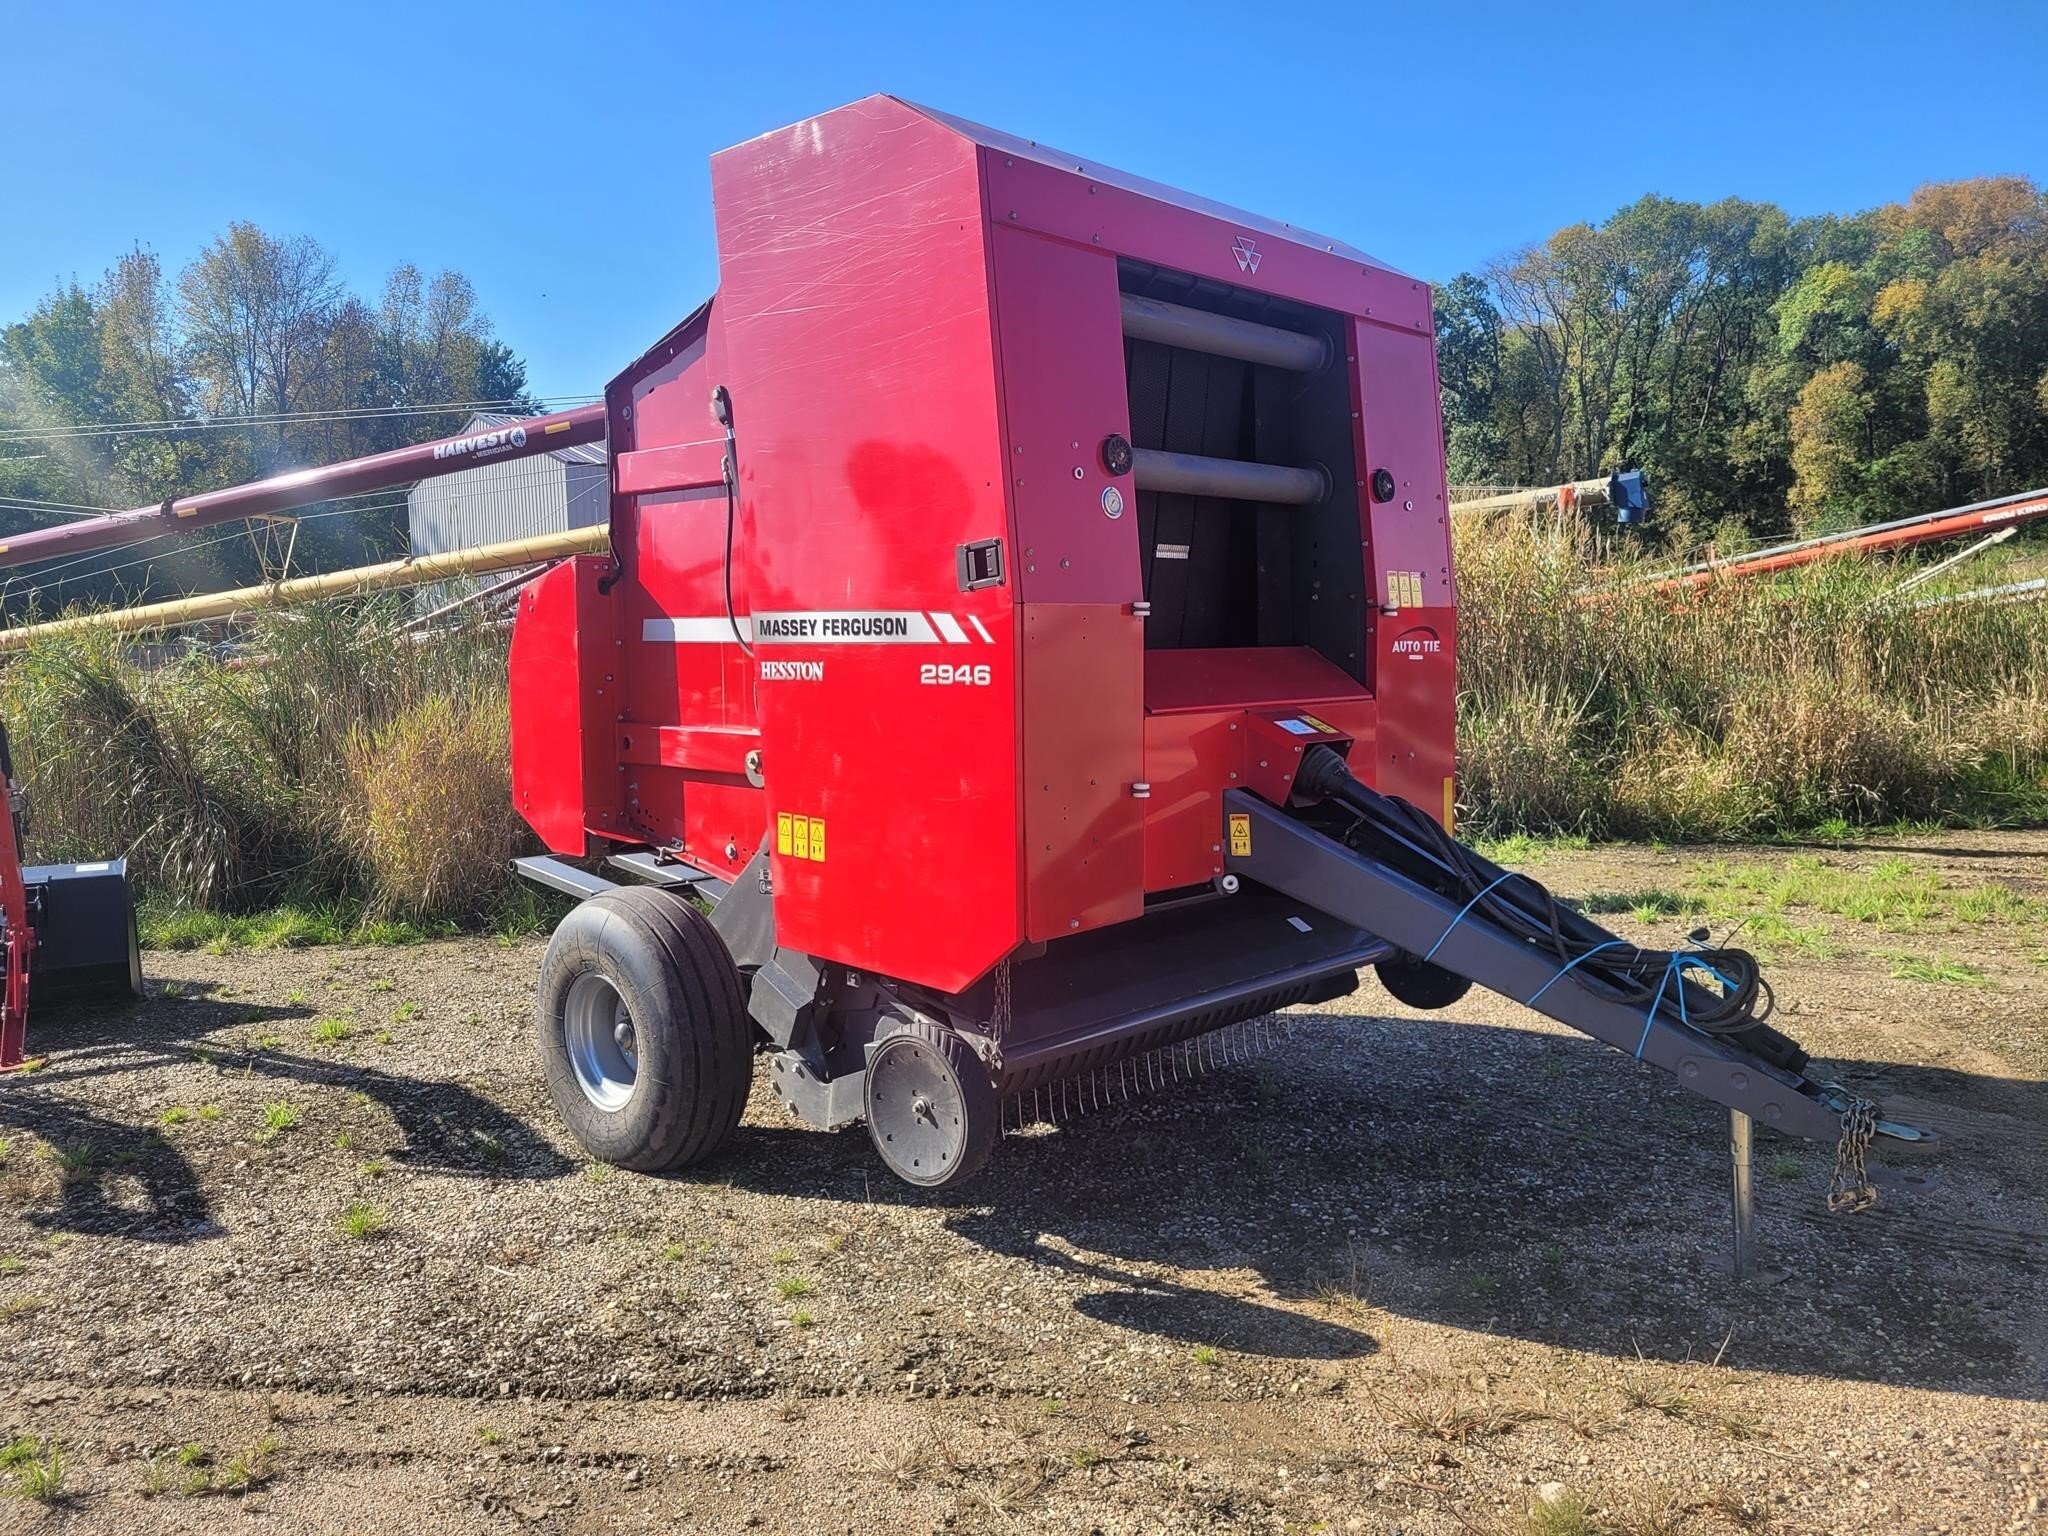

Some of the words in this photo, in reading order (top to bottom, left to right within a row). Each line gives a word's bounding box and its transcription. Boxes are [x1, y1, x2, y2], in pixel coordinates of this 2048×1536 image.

[433, 429, 510, 460] HARVEST
[476, 443, 513, 458] MERIDIAN
[759, 618, 817, 637] MASSEY
[822, 617, 908, 636] FERGUSON
[1391, 640, 1421, 653] AUTO
[1423, 640, 1441, 653] TIE
[760, 660, 824, 682] HESSTON
[920, 663, 992, 686] 2946
